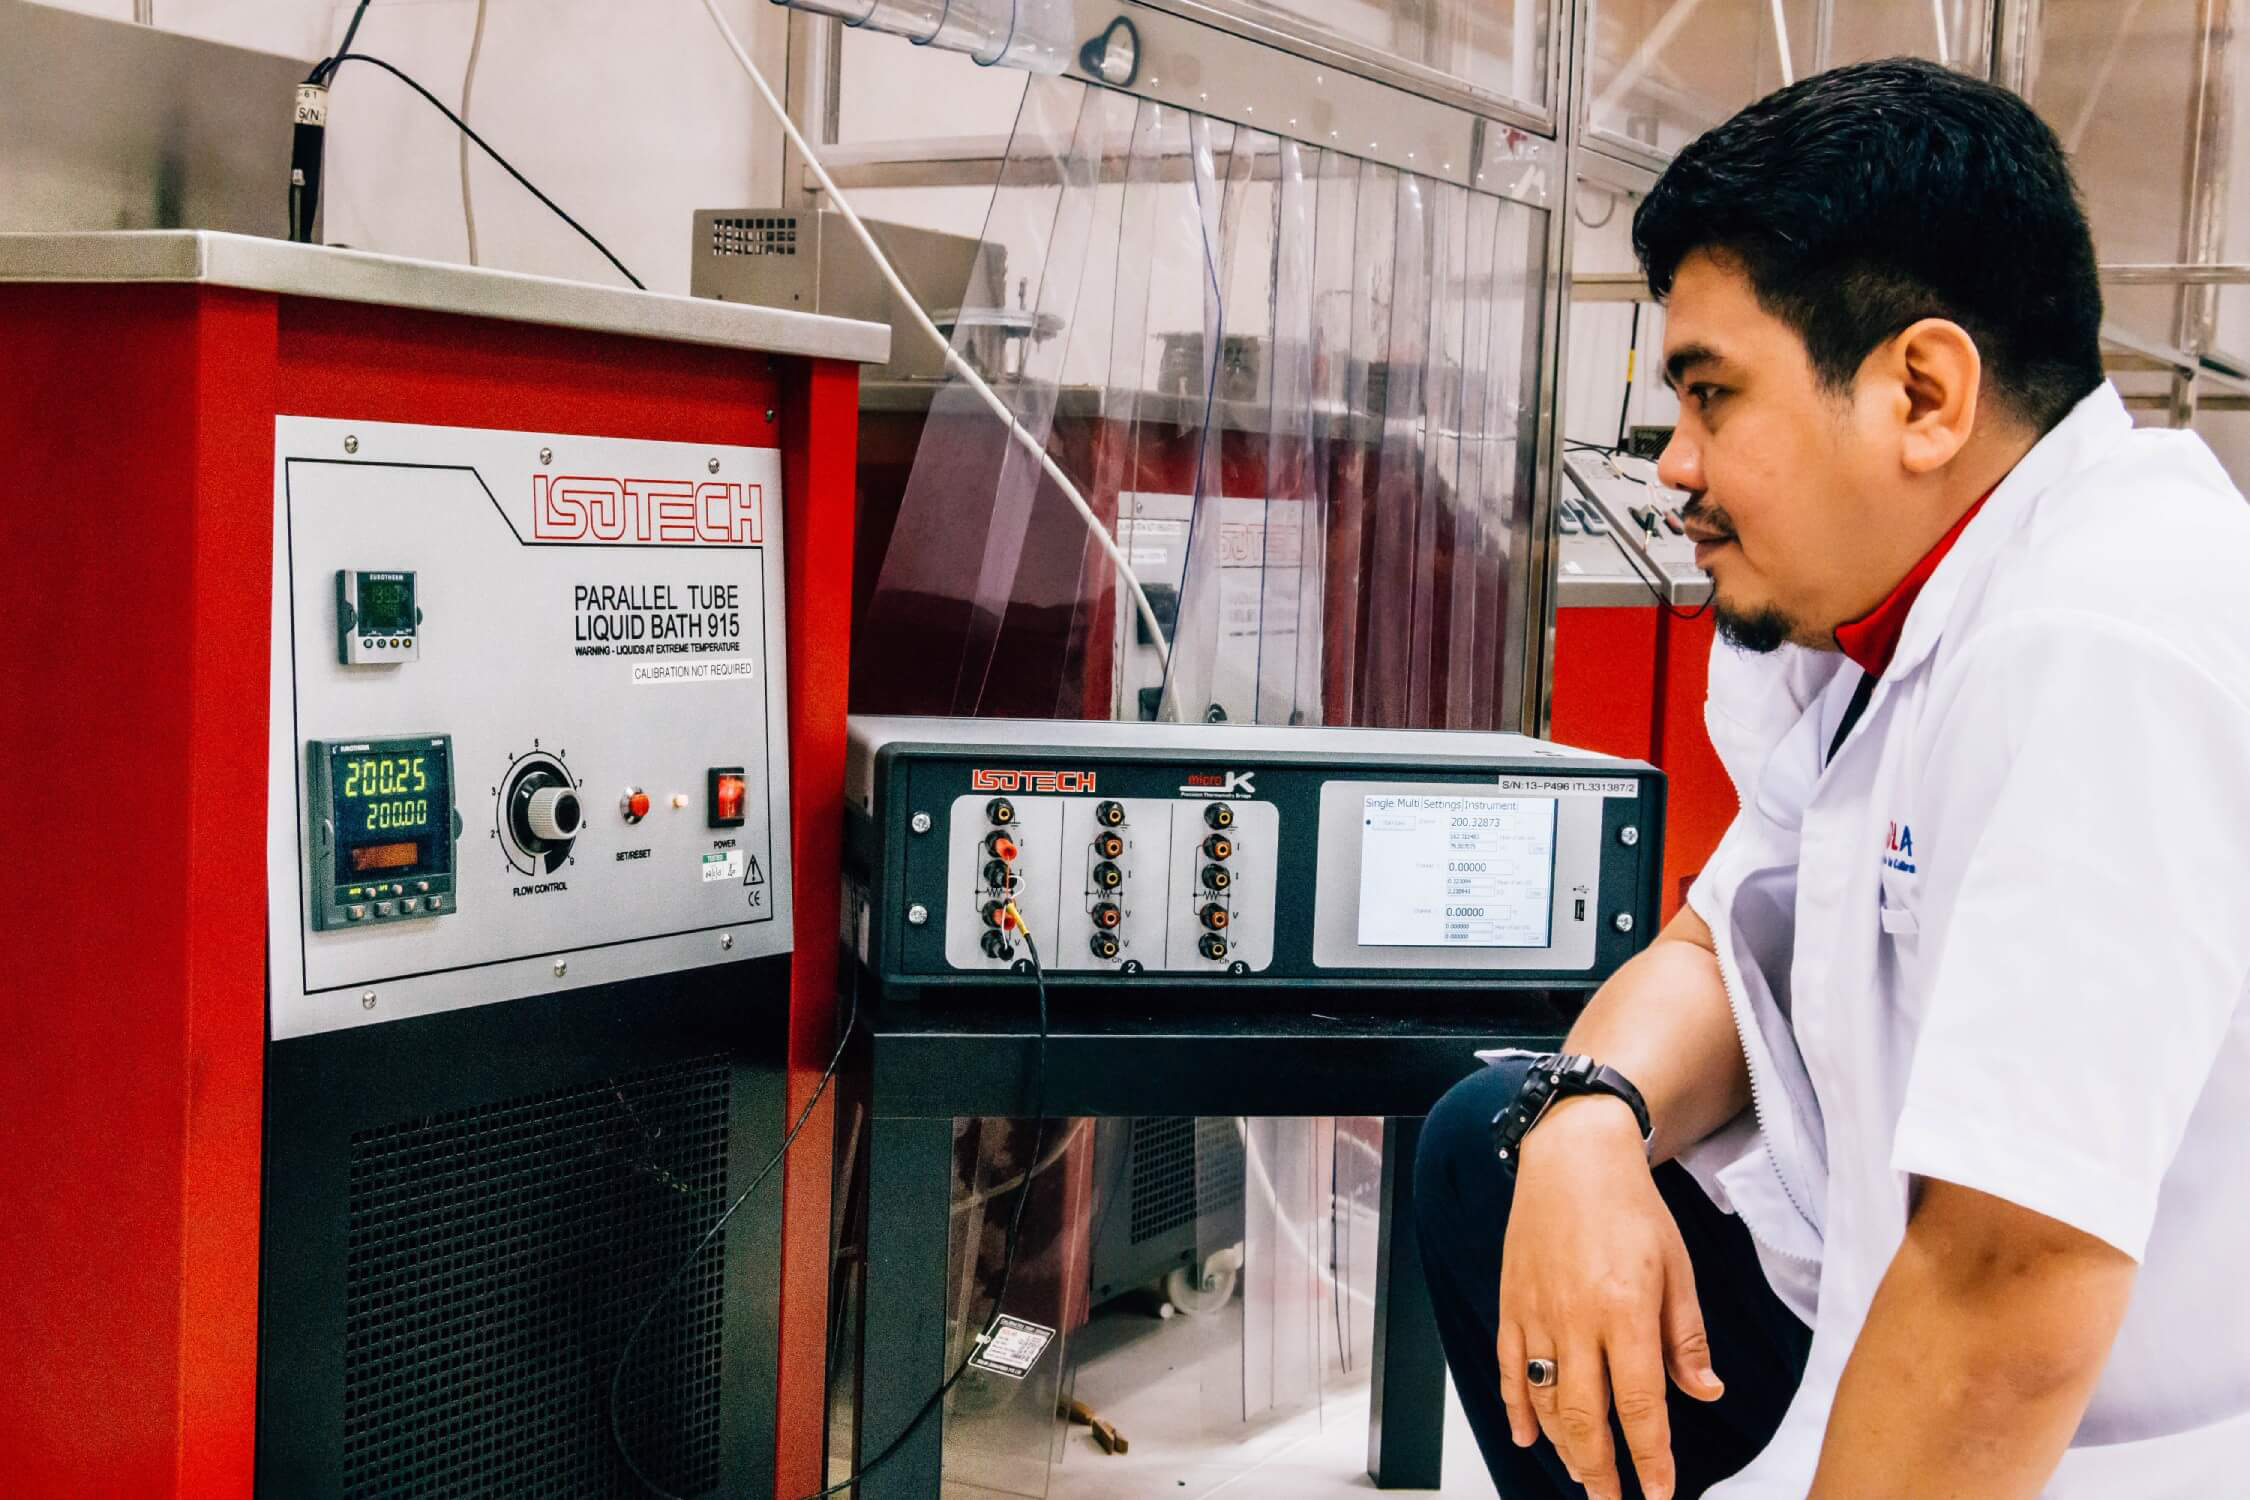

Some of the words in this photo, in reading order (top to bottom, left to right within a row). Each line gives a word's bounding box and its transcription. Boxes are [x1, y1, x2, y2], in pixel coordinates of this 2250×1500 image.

[533, 474, 763, 543] ISOTECH
[575, 585, 678, 611] PARALLEL
[687, 584, 739, 610] TUBE
[575, 614, 645, 641] LIQUID
[651, 613, 702, 639] BATH
[708, 612, 740, 638] 915
[575, 645, 610, 656] WARNING
[616, 644, 645, 655] LIQUIDS
[646, 643, 655, 654] AT
[656, 642, 689, 653] EXTREME
[691, 641, 740, 653] TEMPERATURE
[634, 665, 689, 680] CALIBRATION
[691, 664, 709, 678] NOT
[710, 662, 752, 676] REQUIRED
[534, 738, 540, 747] 5
[508, 752, 513, 761] 4
[345, 758, 426, 797] 200.25
[972, 768, 1096, 792] ISOTECH
[1365, 799, 1394, 810] Single
[1397, 799, 1420, 808] Multi
[1423, 800, 1462, 811] Settings
[1464, 801, 1517, 811] Instrument
[366, 799, 427, 830] 200.00
[1451, 817, 1500, 828] 200.32873
[490, 830, 495, 839] 2
[713, 839, 736, 849] POWER
[616, 848, 651, 862] SET/RESET
[1448, 862, 1487, 872] 0.00000
[513, 886, 534, 897] FLOW
[534, 881, 568, 894] CONTROL
[1446, 907, 1485, 917] 0.00000
[1019, 962, 1026, 972] 1
[1127, 963, 1136, 974] 2
[1235, 963, 1243, 974] 3
